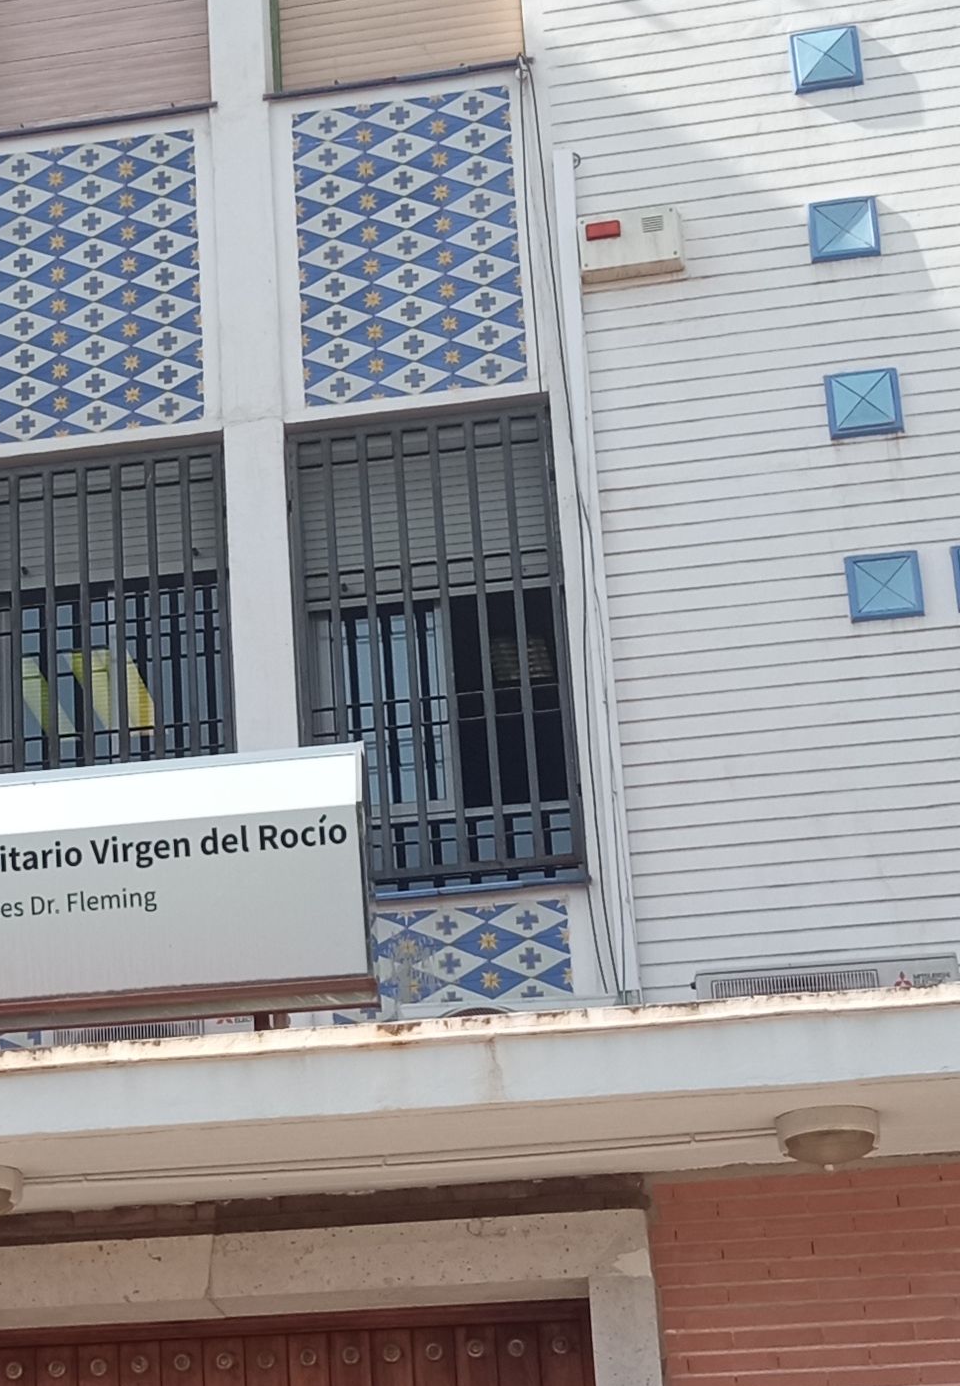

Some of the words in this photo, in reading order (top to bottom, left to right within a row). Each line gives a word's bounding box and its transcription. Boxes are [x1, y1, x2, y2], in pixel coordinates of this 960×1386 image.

[90, 837, 190, 868] Virgen
[200, 825, 248, 855] del
[259, 814, 347, 850] Rocío
[31, 896, 60, 915] Dr.
[67, 888, 157, 913] Fleming
